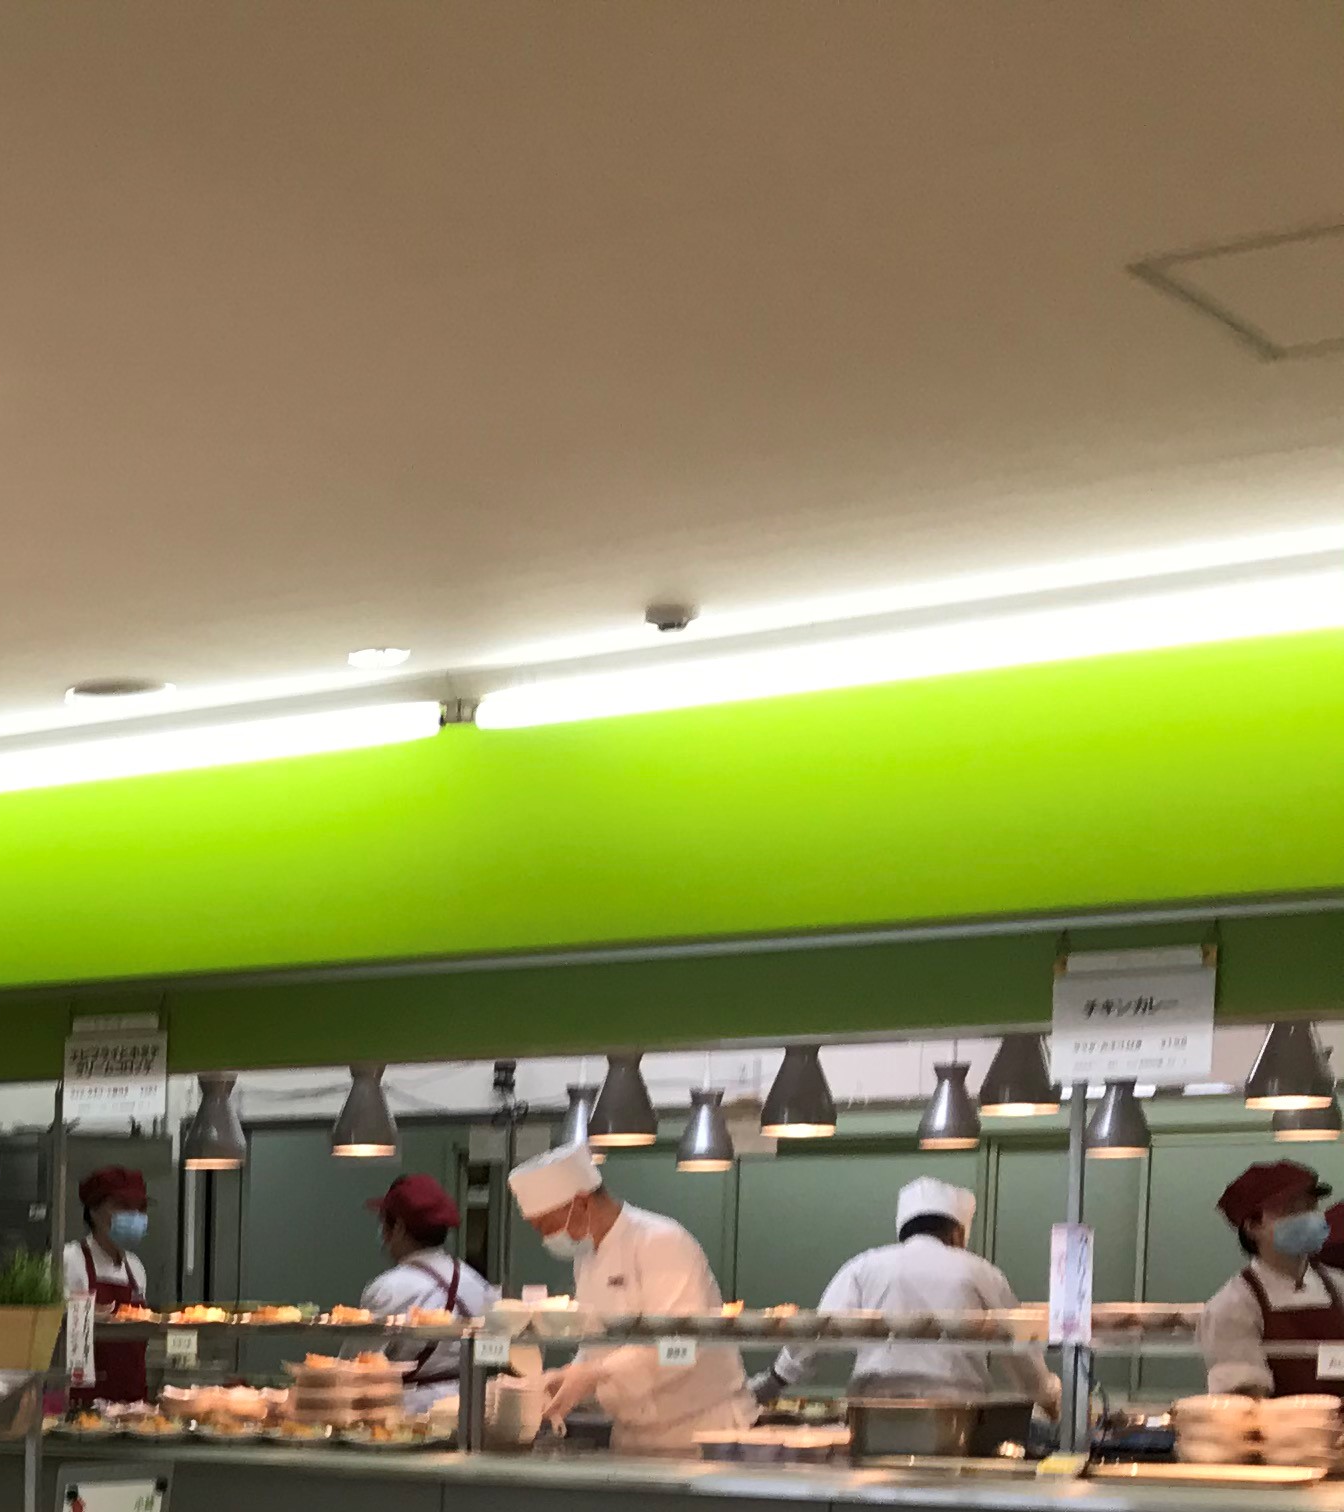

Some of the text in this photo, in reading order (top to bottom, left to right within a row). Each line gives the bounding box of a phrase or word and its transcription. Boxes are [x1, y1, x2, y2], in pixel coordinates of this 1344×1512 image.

[1083, 995, 1179, 1019] チキンカレー
